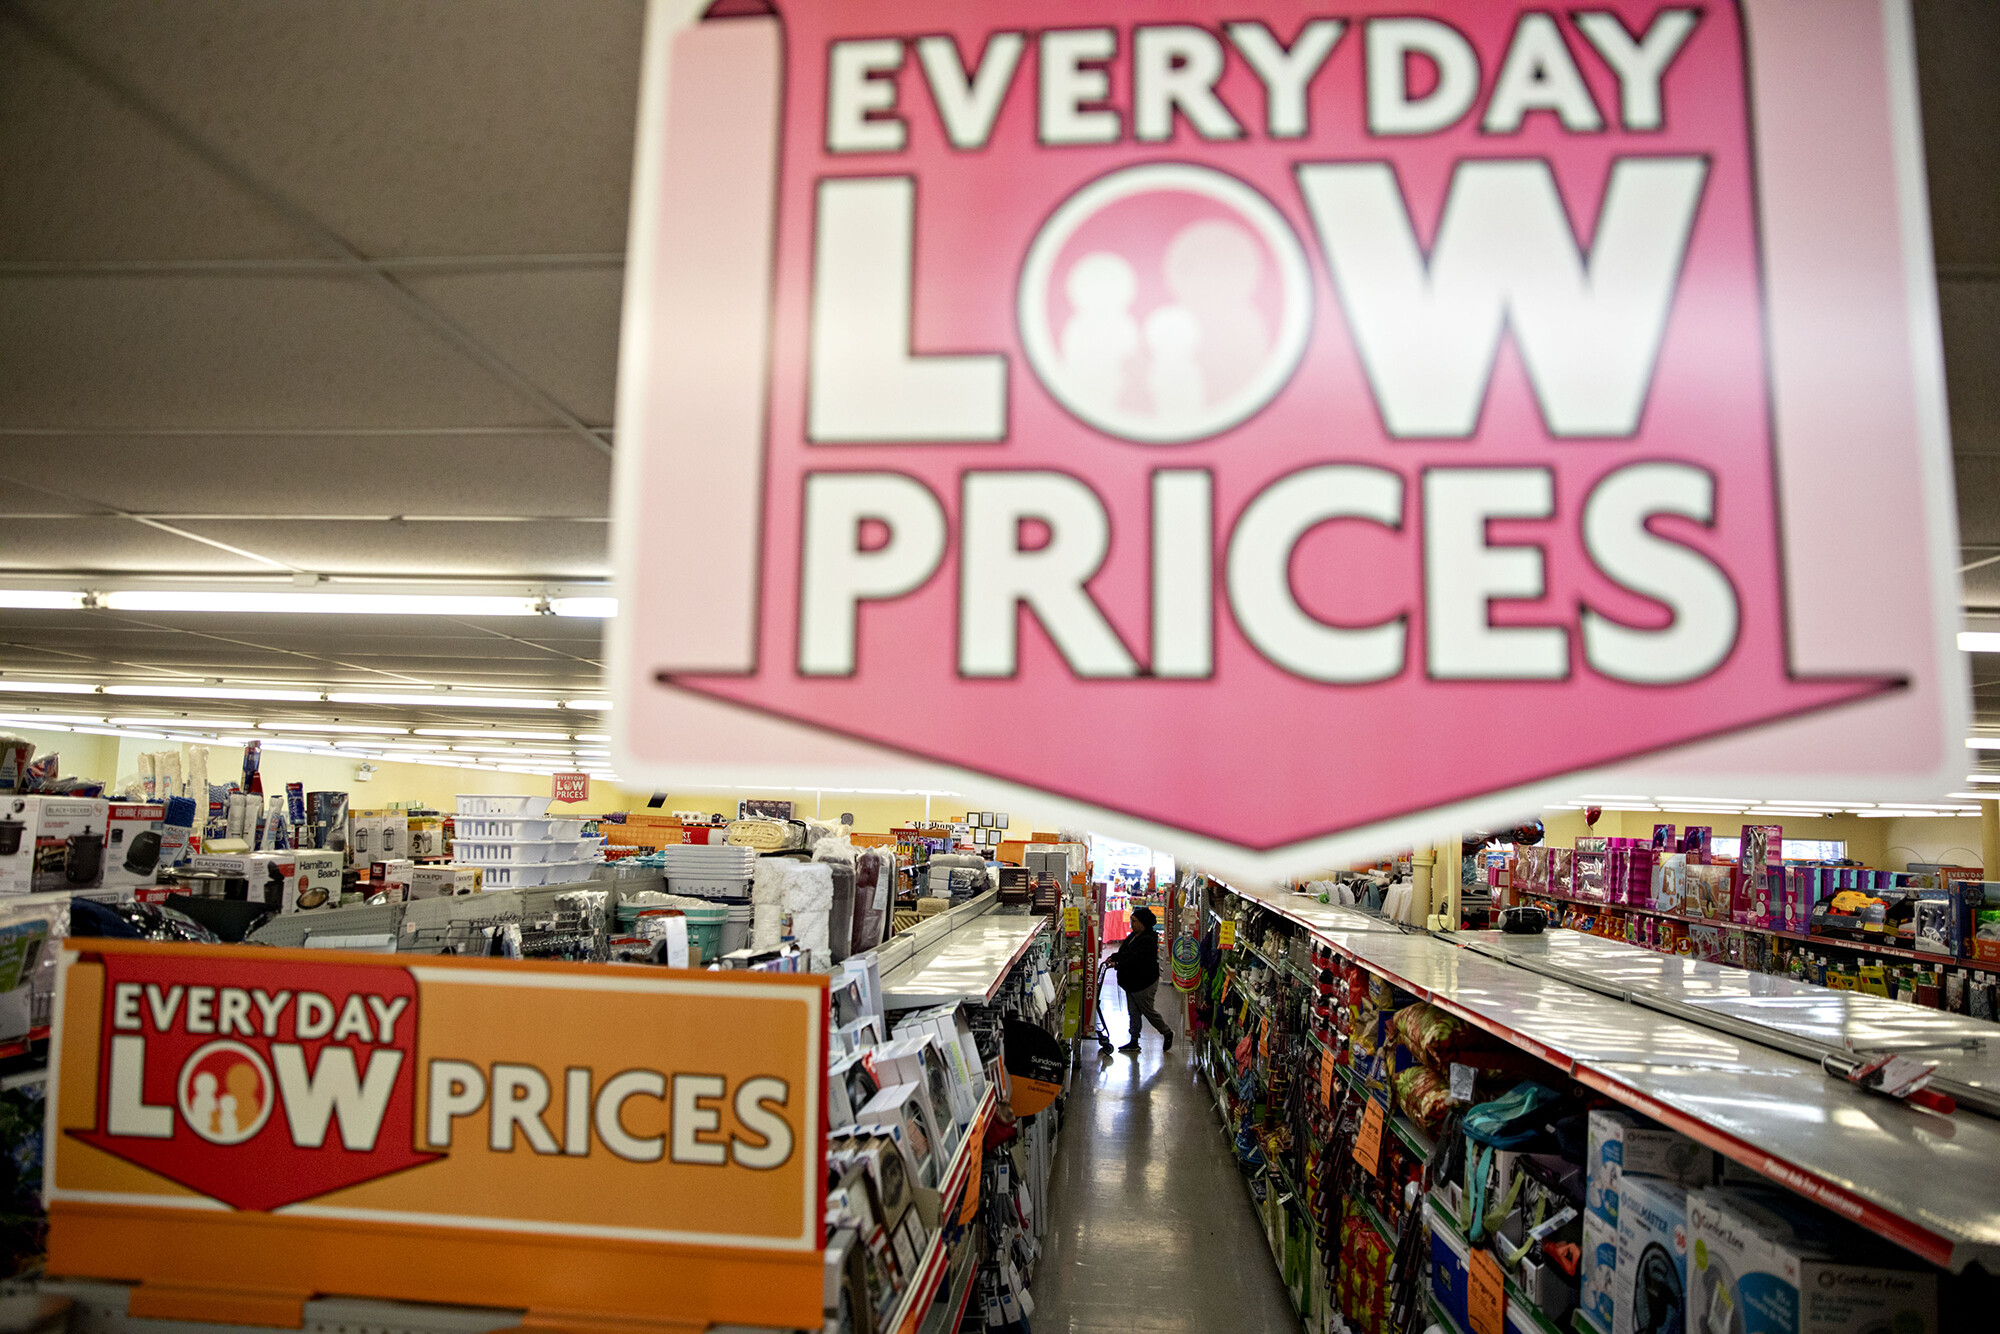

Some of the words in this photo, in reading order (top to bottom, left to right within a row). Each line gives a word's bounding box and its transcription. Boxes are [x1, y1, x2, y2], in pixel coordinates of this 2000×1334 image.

[824, 8, 1700, 155] EVERYDAY
[806, 156, 1711, 445] LOW
[798, 460, 1741, 686] PRICES
[556, 780, 584, 791] LOW
[556, 790, 584, 799] PRICES
[115, 808, 137, 817] GEORGE
[137, 809, 163, 818] FOREMAN
[197, 861, 242, 870] BLACK+DECKER
[299, 860, 333, 871] Hamilton
[317, 869, 341, 879] Beach
[1947, 871, 1984, 880] EVERYDAY
[1087, 952, 1095, 972] LOW
[1085, 972, 1094, 1000] PRICES
[112, 982, 408, 1043] EVERYDAY
[1031, 1055, 1062, 1068] Sundown
[106, 1034, 404, 1153] LOW
[424, 1057, 795, 1170] PRICES
